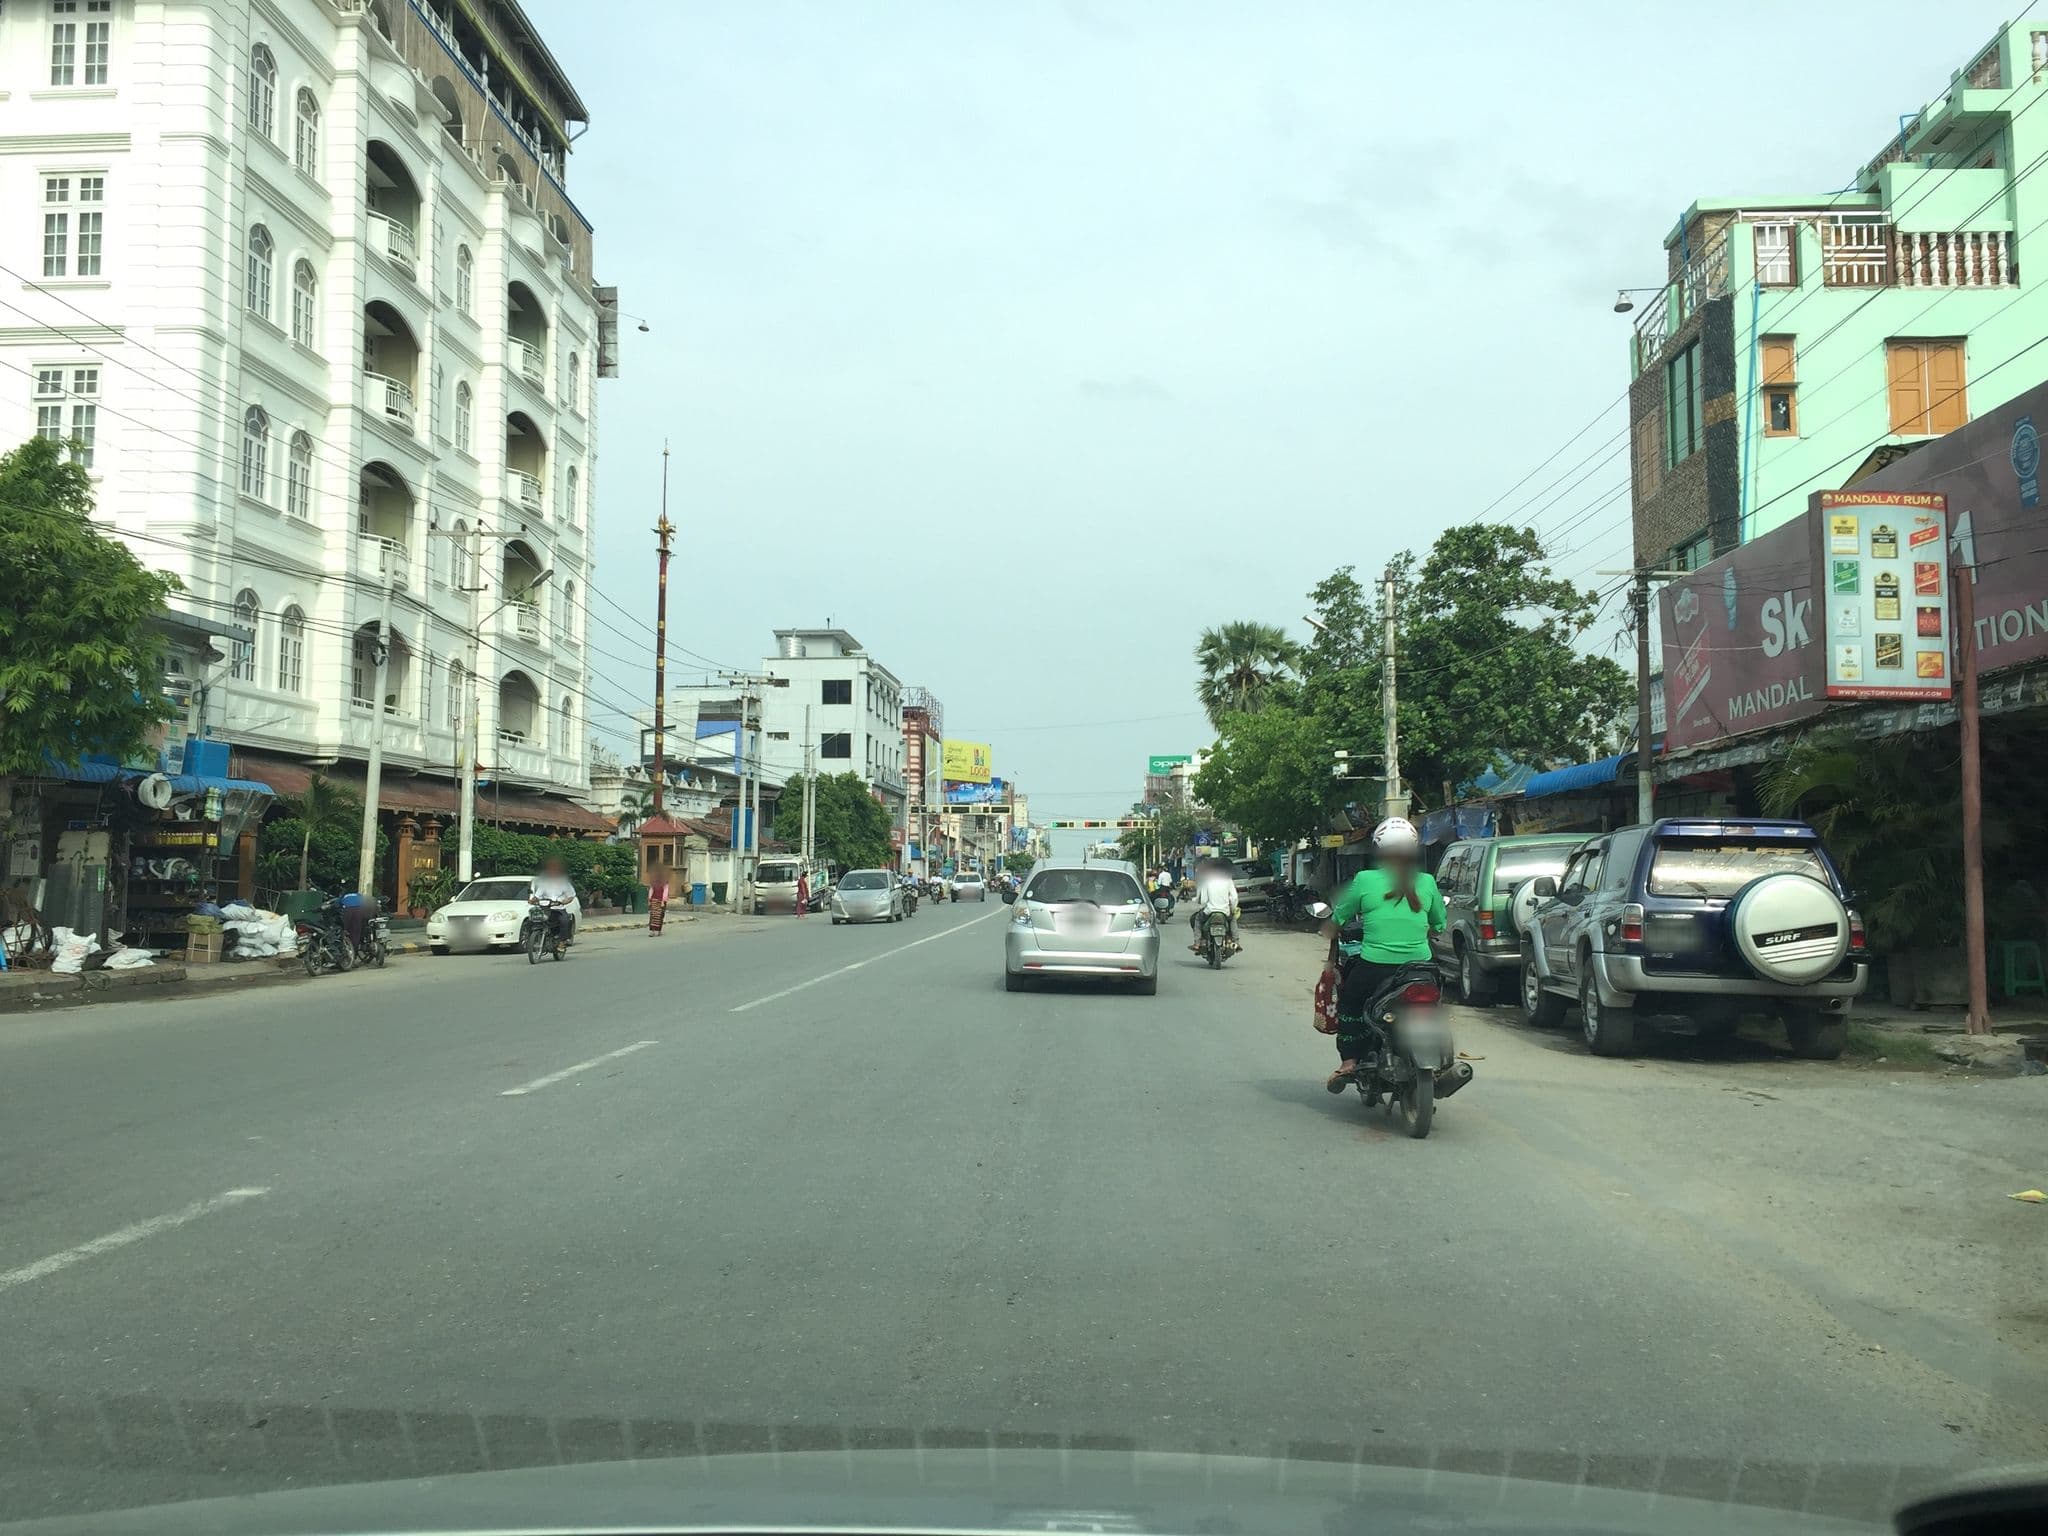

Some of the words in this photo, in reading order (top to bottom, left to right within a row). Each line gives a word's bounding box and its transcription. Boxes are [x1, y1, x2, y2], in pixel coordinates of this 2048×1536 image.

[1834, 494, 1900, 504] MANDALAY
[1903, 495, 1931, 505] RUM
[1761, 590, 1812, 658] Sk
[1953, 599, 2048, 657] TION
[1765, 932, 1801, 945] SURF
